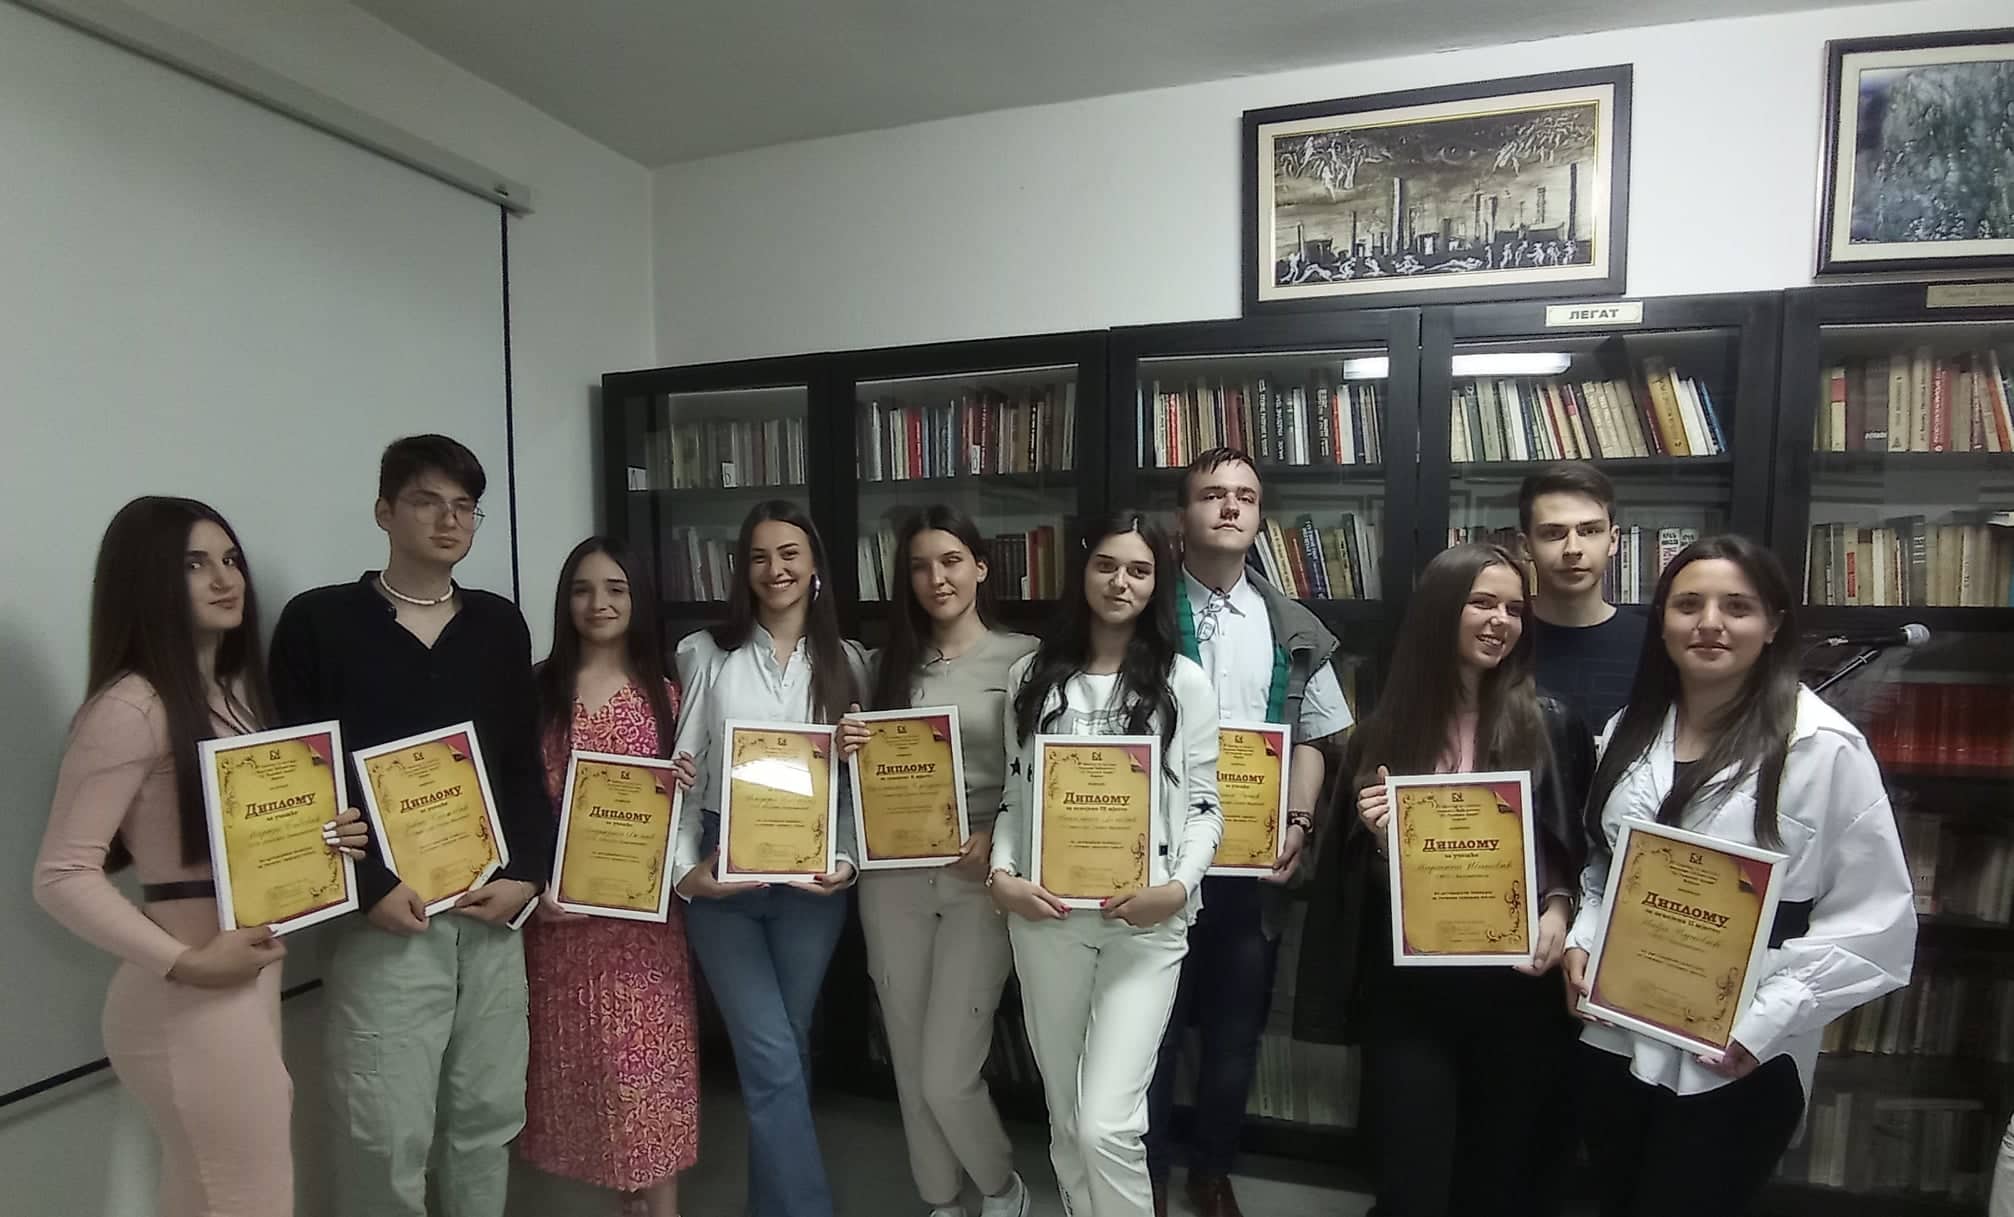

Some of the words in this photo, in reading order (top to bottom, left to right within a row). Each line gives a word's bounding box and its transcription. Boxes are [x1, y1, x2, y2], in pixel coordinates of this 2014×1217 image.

[1569, 309, 1620, 320] ЛЕГАТ
[876, 763, 936, 775] Диплому
[244, 792, 316, 819] Диплому
[399, 785, 463, 814] Диплому
[1063, 792, 1131, 806] Диплому
[589, 806, 652, 824] Диплому
[1422, 838, 1500, 852] Диплому
[1641, 891, 1731, 929] Диплому
